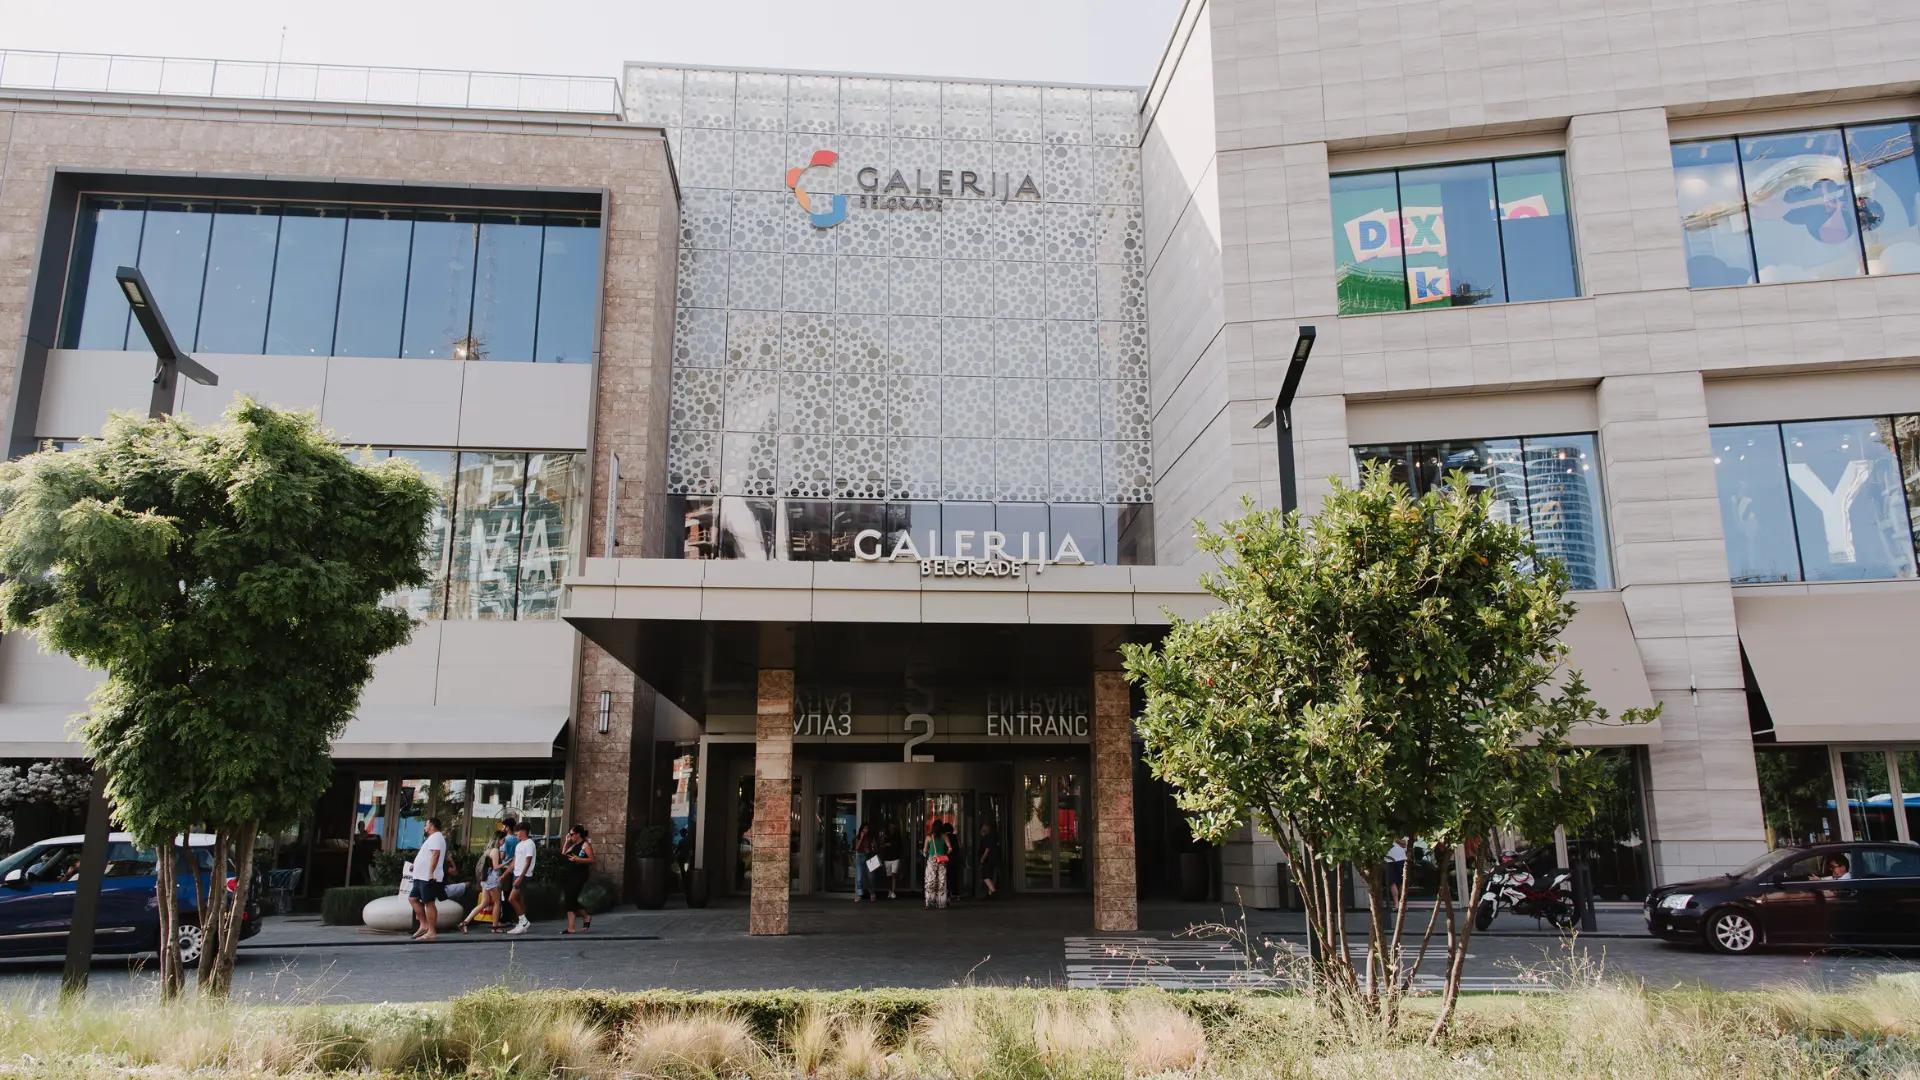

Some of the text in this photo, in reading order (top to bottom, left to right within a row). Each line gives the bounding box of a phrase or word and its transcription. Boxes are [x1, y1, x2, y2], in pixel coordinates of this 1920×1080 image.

[857, 167, 1041, 206] GALERIJA
[859, 194, 943, 212] BELGRADE
[1359, 215, 1442, 250] DEX
[853, 529, 1087, 573] GALERIJA
[921, 560, 1021, 578] BELGRADE
[793, 714, 852, 736] УЛАЗ
[904, 714, 935, 762] 2
[987, 715, 1088, 736] ENTRANC
